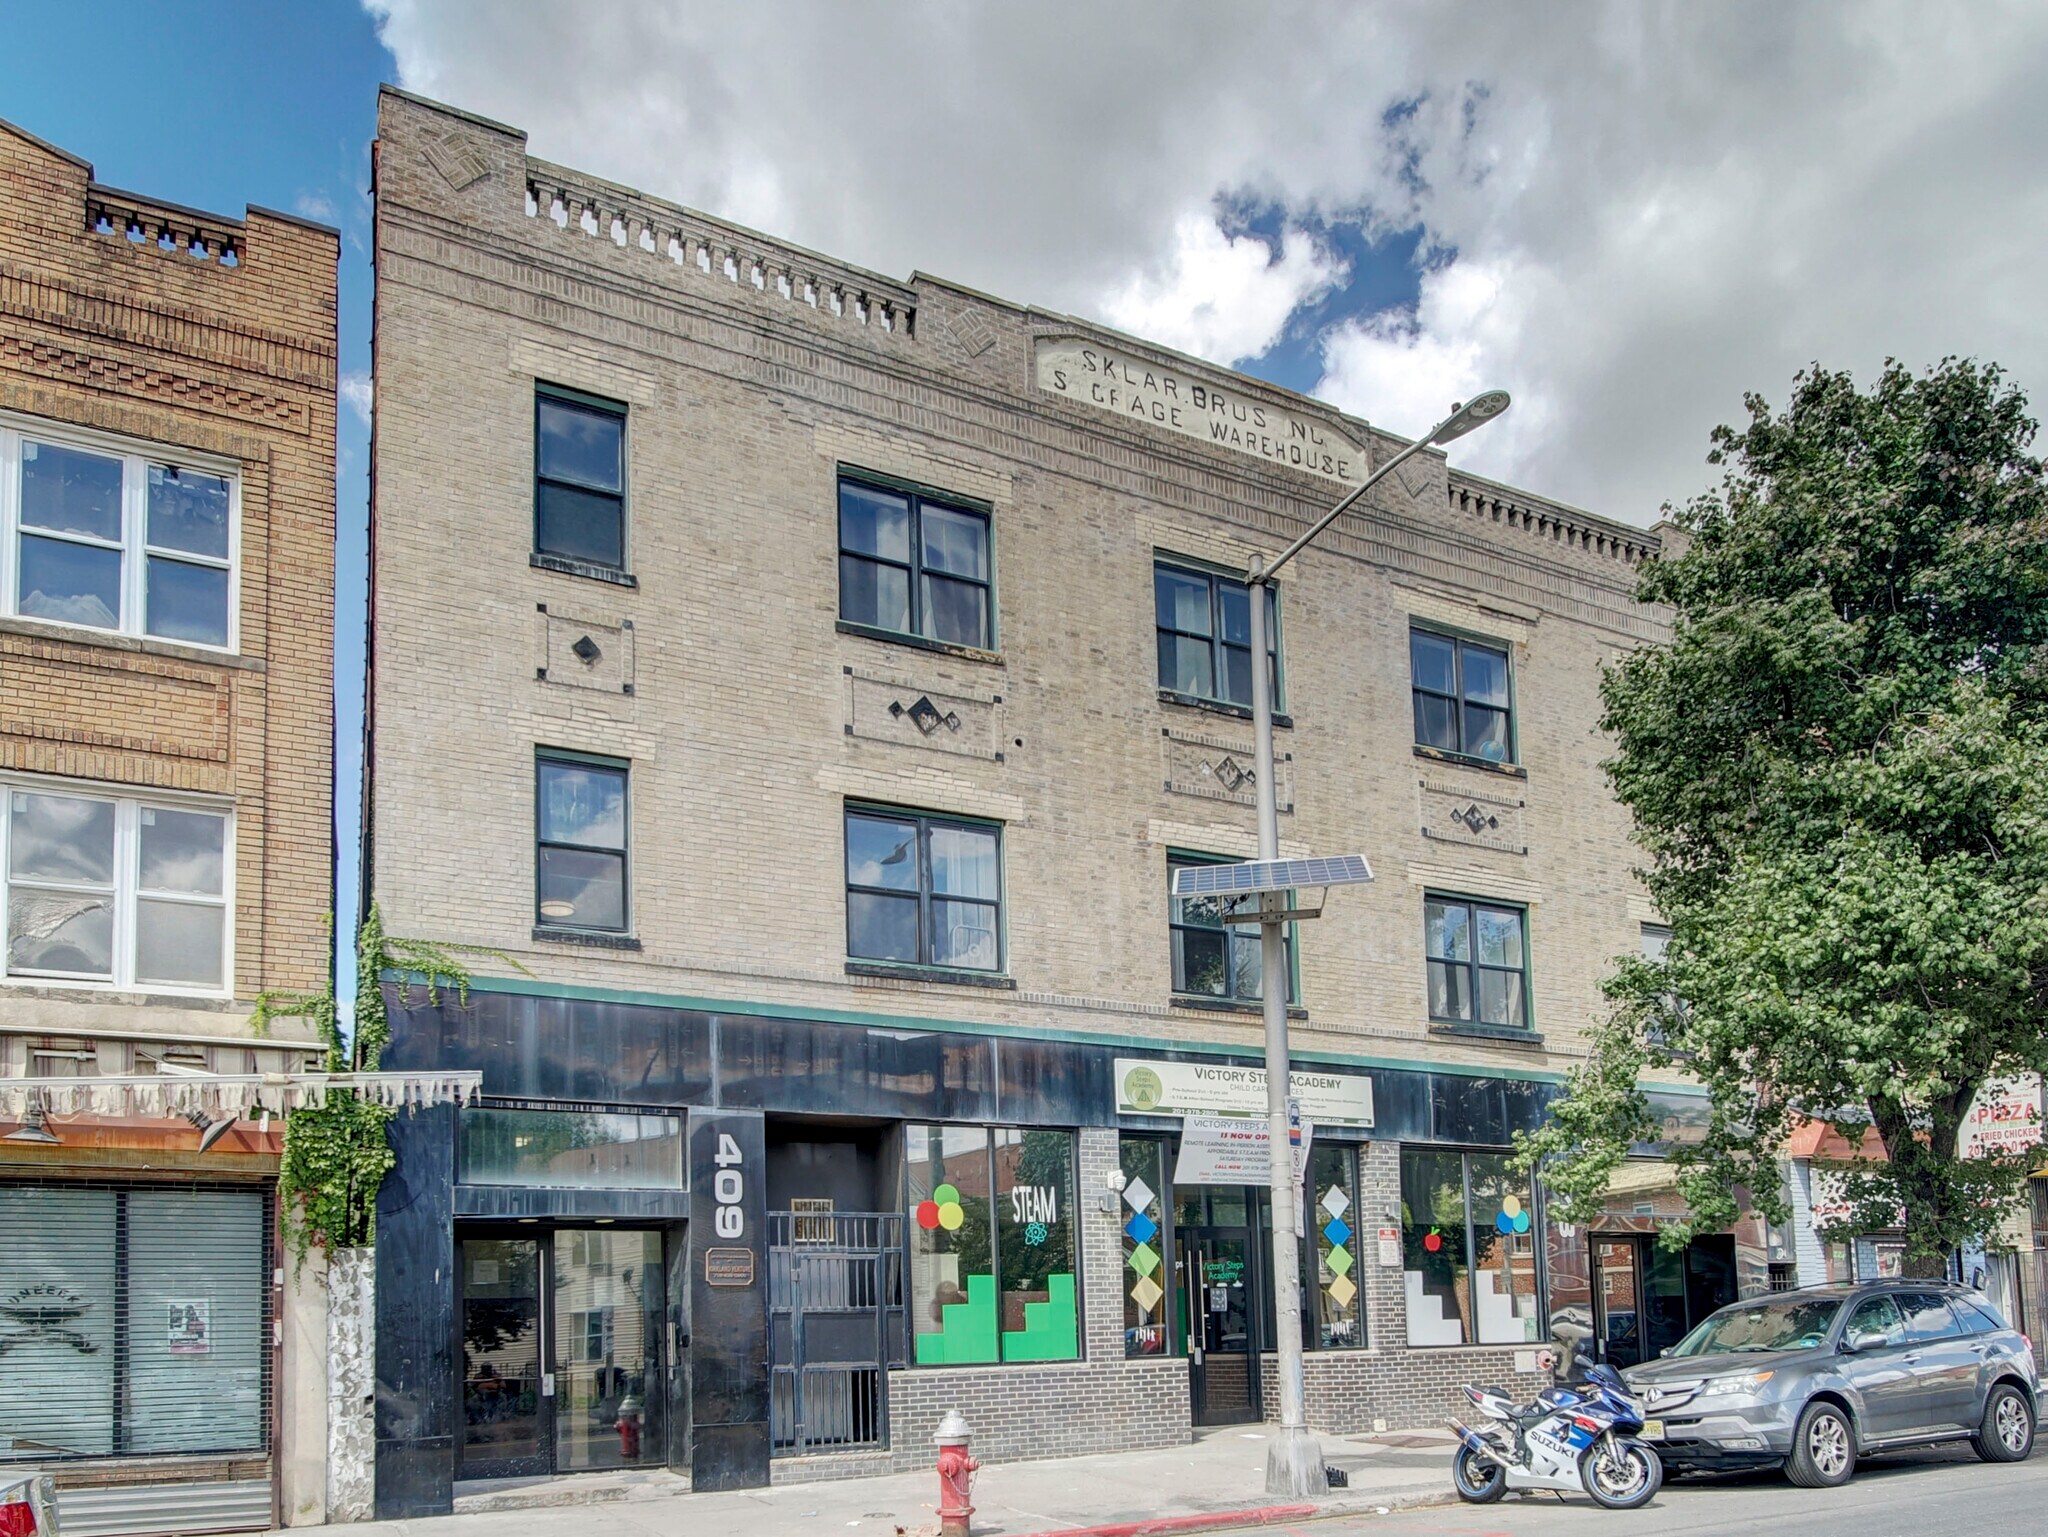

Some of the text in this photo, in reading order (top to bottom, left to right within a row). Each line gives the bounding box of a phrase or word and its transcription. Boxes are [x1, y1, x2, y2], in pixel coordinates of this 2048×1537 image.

[1208, 420, 1350, 480] WAREHOUSE
[1194, 1067, 1246, 1082] VICTORY
[1289, 1075, 1342, 1089] ACADEMY
[1229, 1083, 1251, 1092] CHILD
[1977, 1102, 2037, 1125] PIZZA
[1193, 1119, 1233, 1130] VICTORY
[1234, 1121, 1260, 1131] STEPS
[2004, 1126, 2040, 1139] CHICKEN
[1230, 1133, 1254, 1141] NOW
[714, 1133, 744, 1239] 409
[1012, 1185, 1057, 1224] STEAM
[1226, 1260, 1244, 1271] Steps
[1208, 1271, 1239, 1281] Academy
[1530, 1430, 1575, 1459] SUZUKI
